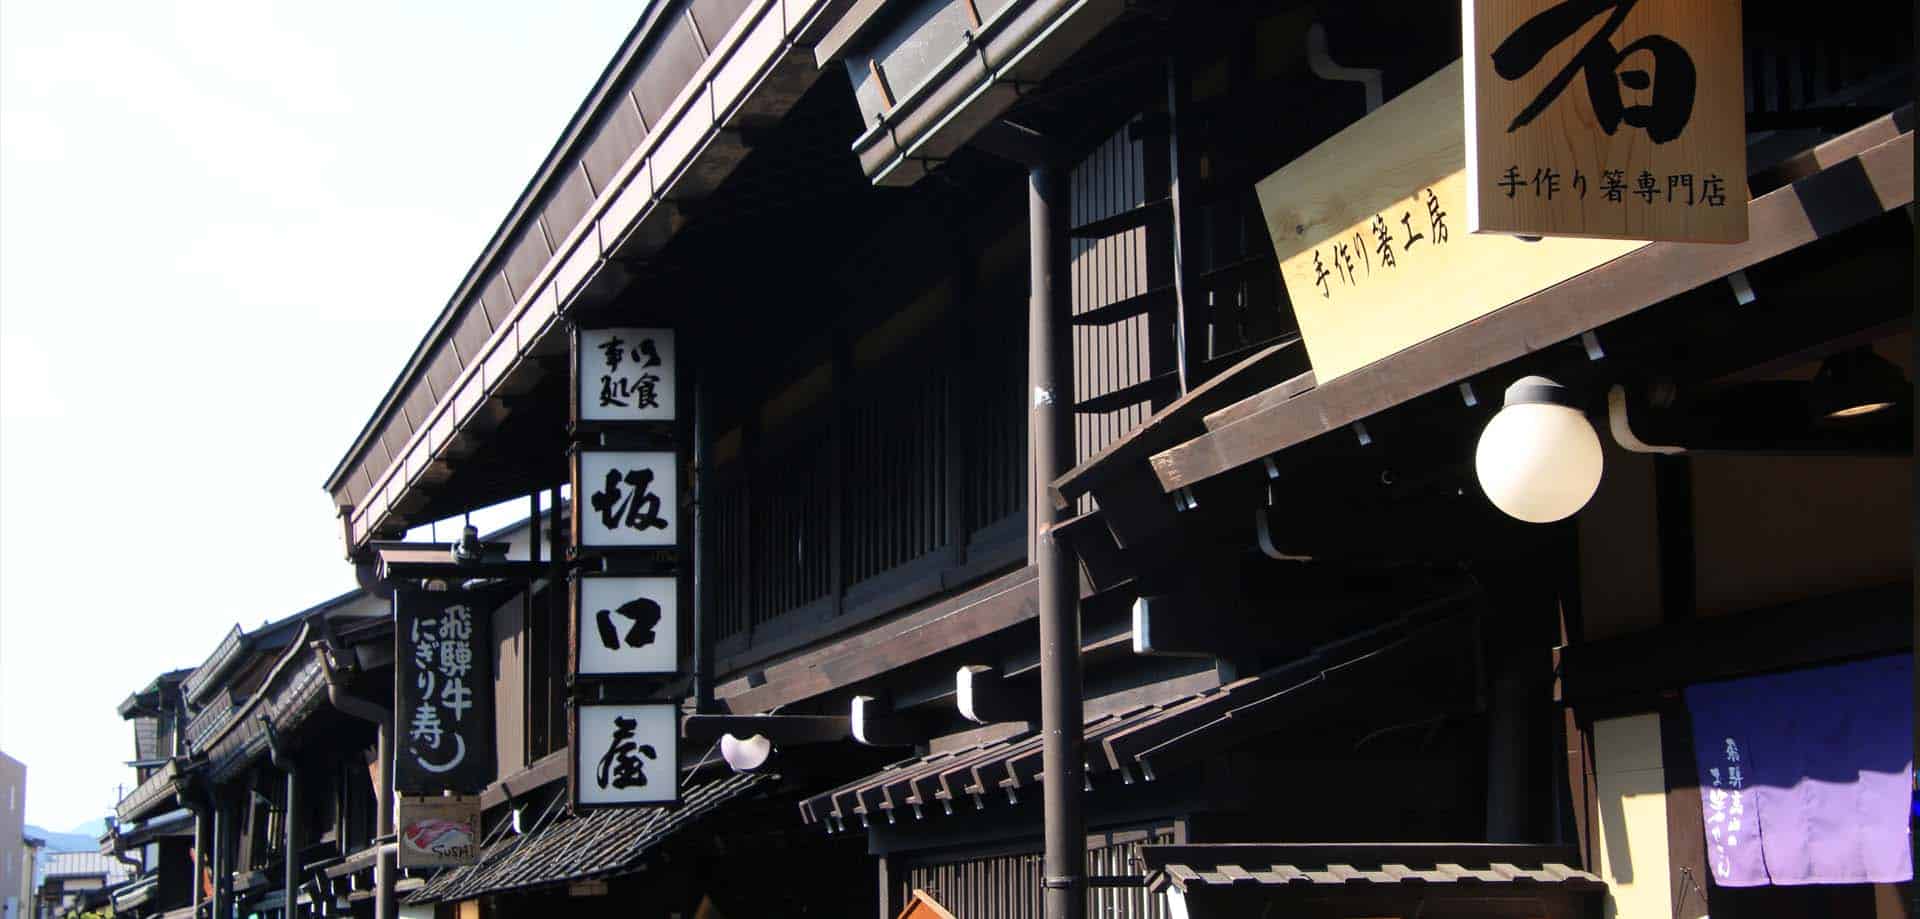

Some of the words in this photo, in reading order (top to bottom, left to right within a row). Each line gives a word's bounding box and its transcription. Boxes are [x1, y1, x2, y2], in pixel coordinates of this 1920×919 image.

[1498, 165, 1726, 207] 手作り箸専門店
[1313, 188, 1448, 299] 手作り箸工房
[439, 604, 472, 721] 飛騨牛
